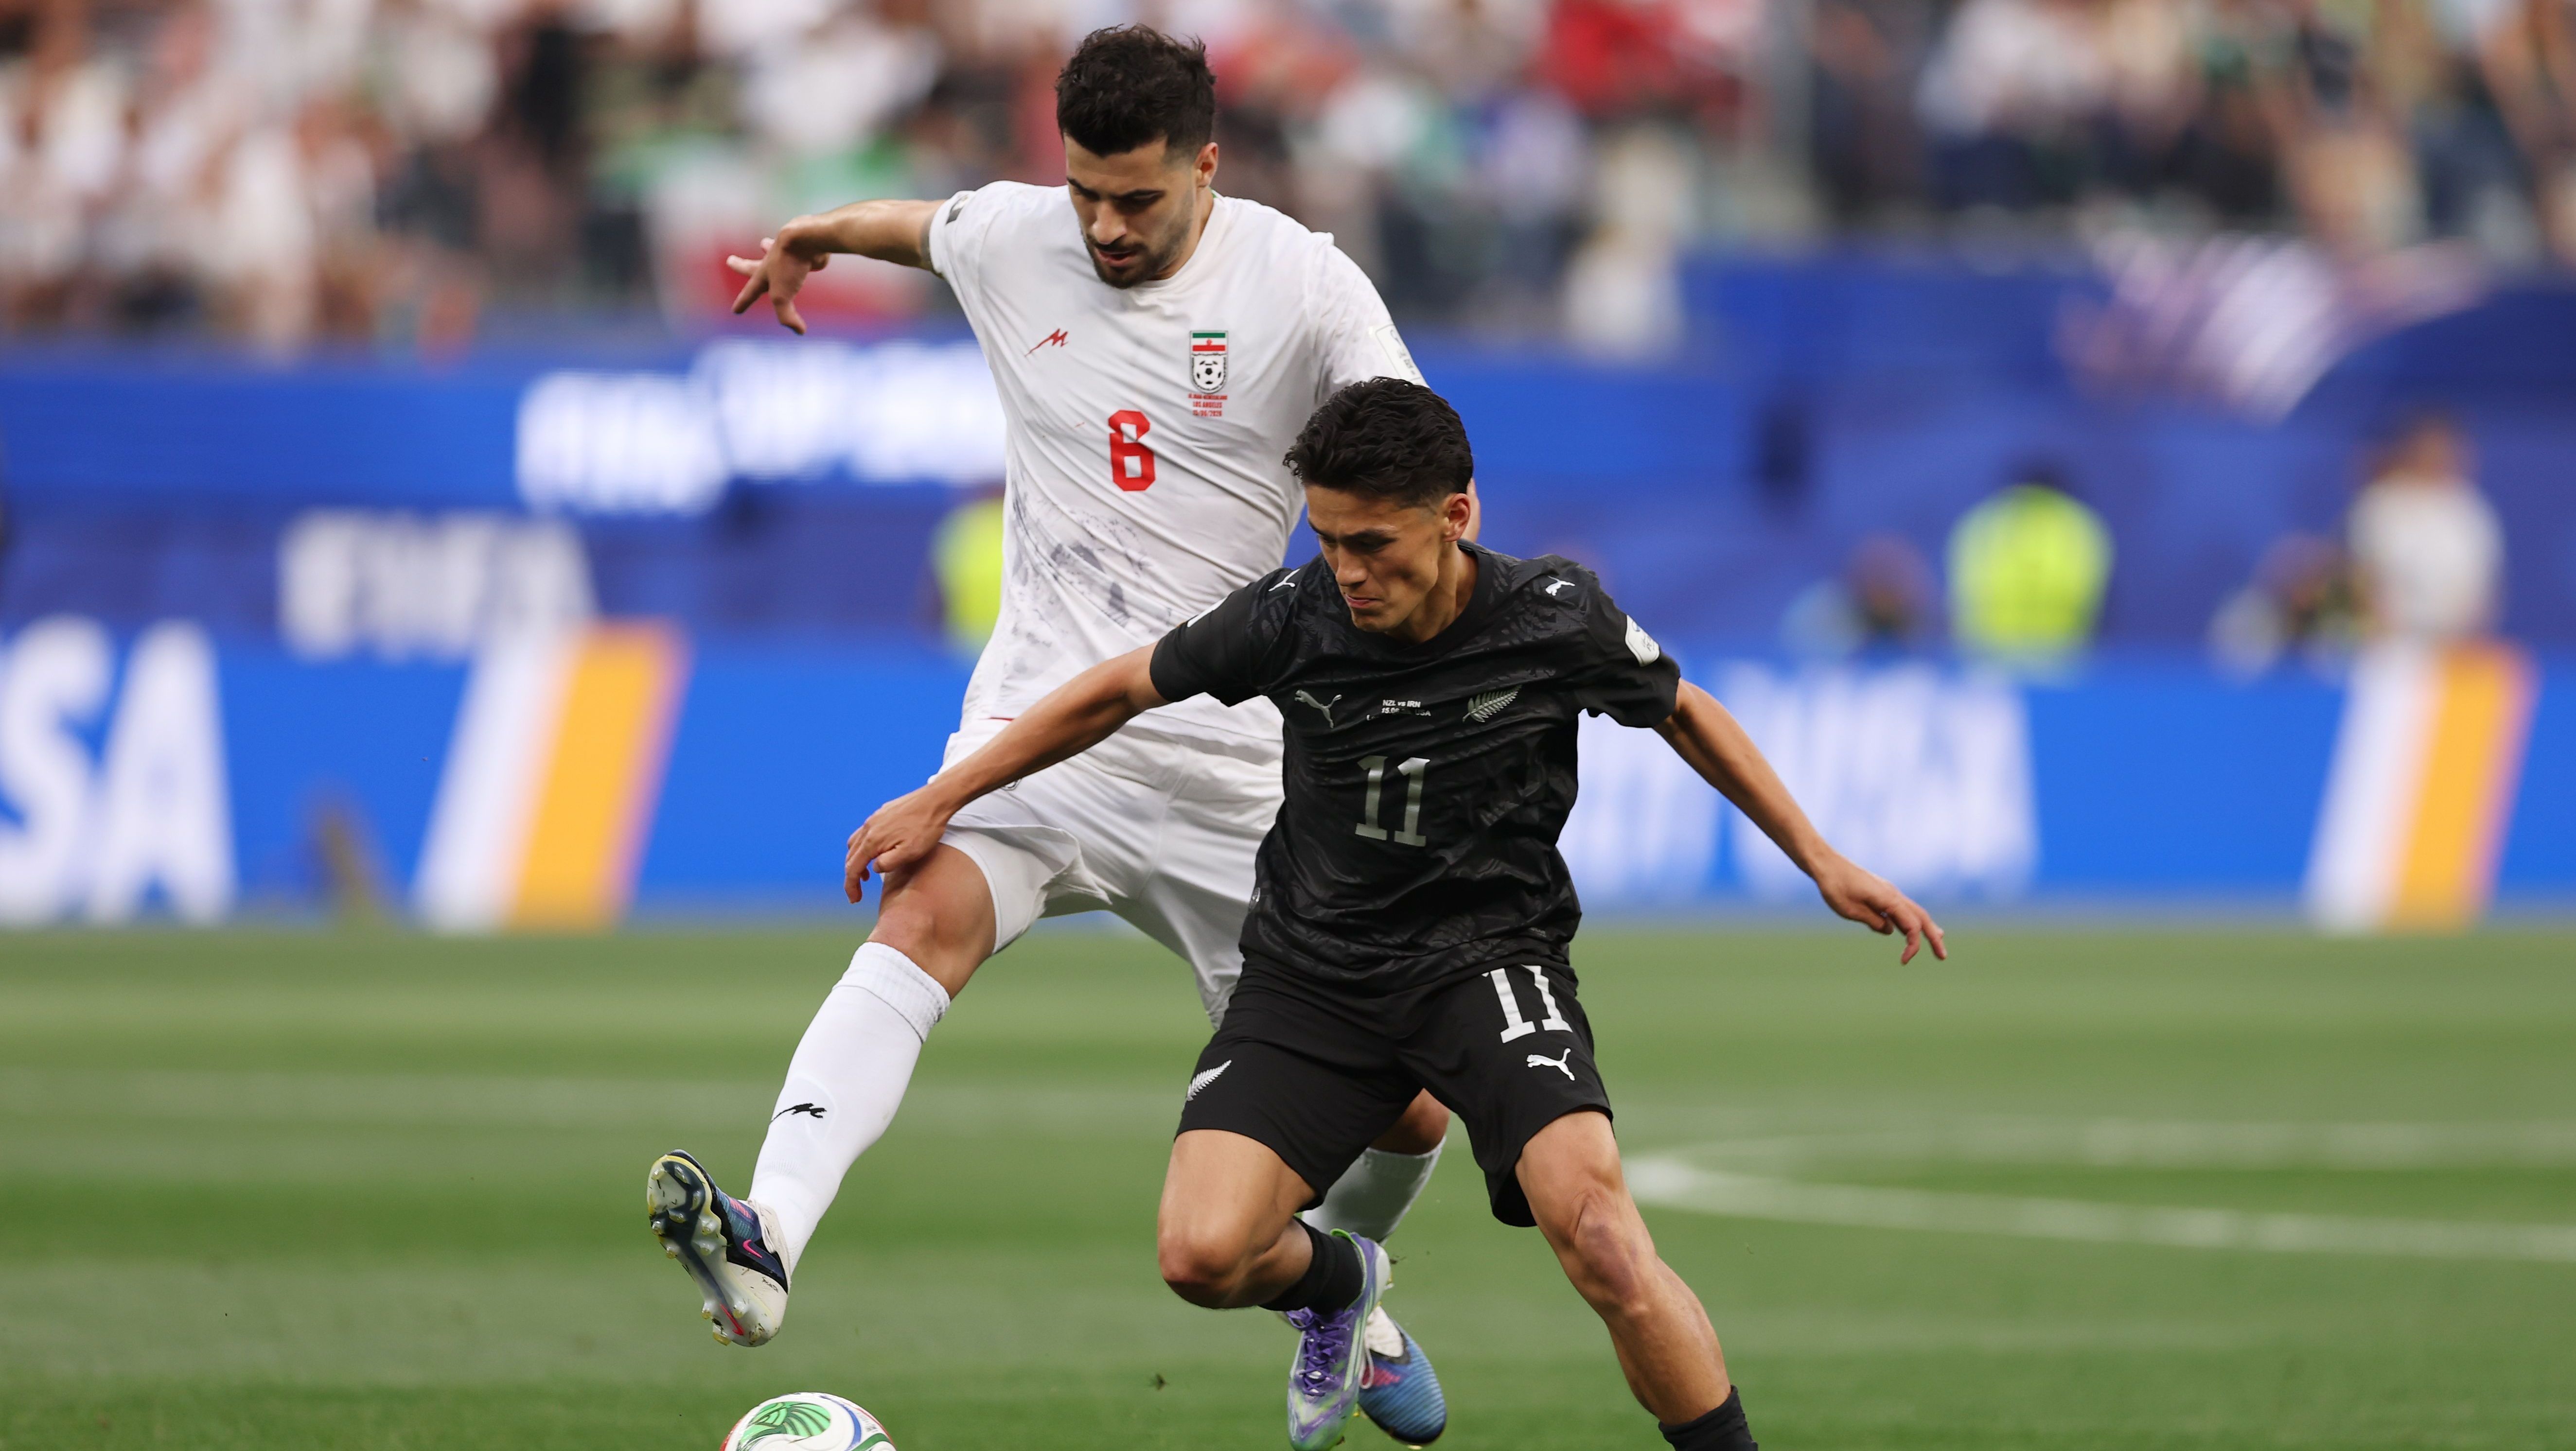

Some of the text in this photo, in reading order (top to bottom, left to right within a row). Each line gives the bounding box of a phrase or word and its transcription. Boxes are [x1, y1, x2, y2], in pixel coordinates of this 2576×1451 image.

[1108, 410, 1156, 491] 6
[1355, 755, 1431, 847] 11
[1481, 964, 1573, 1044] 11
